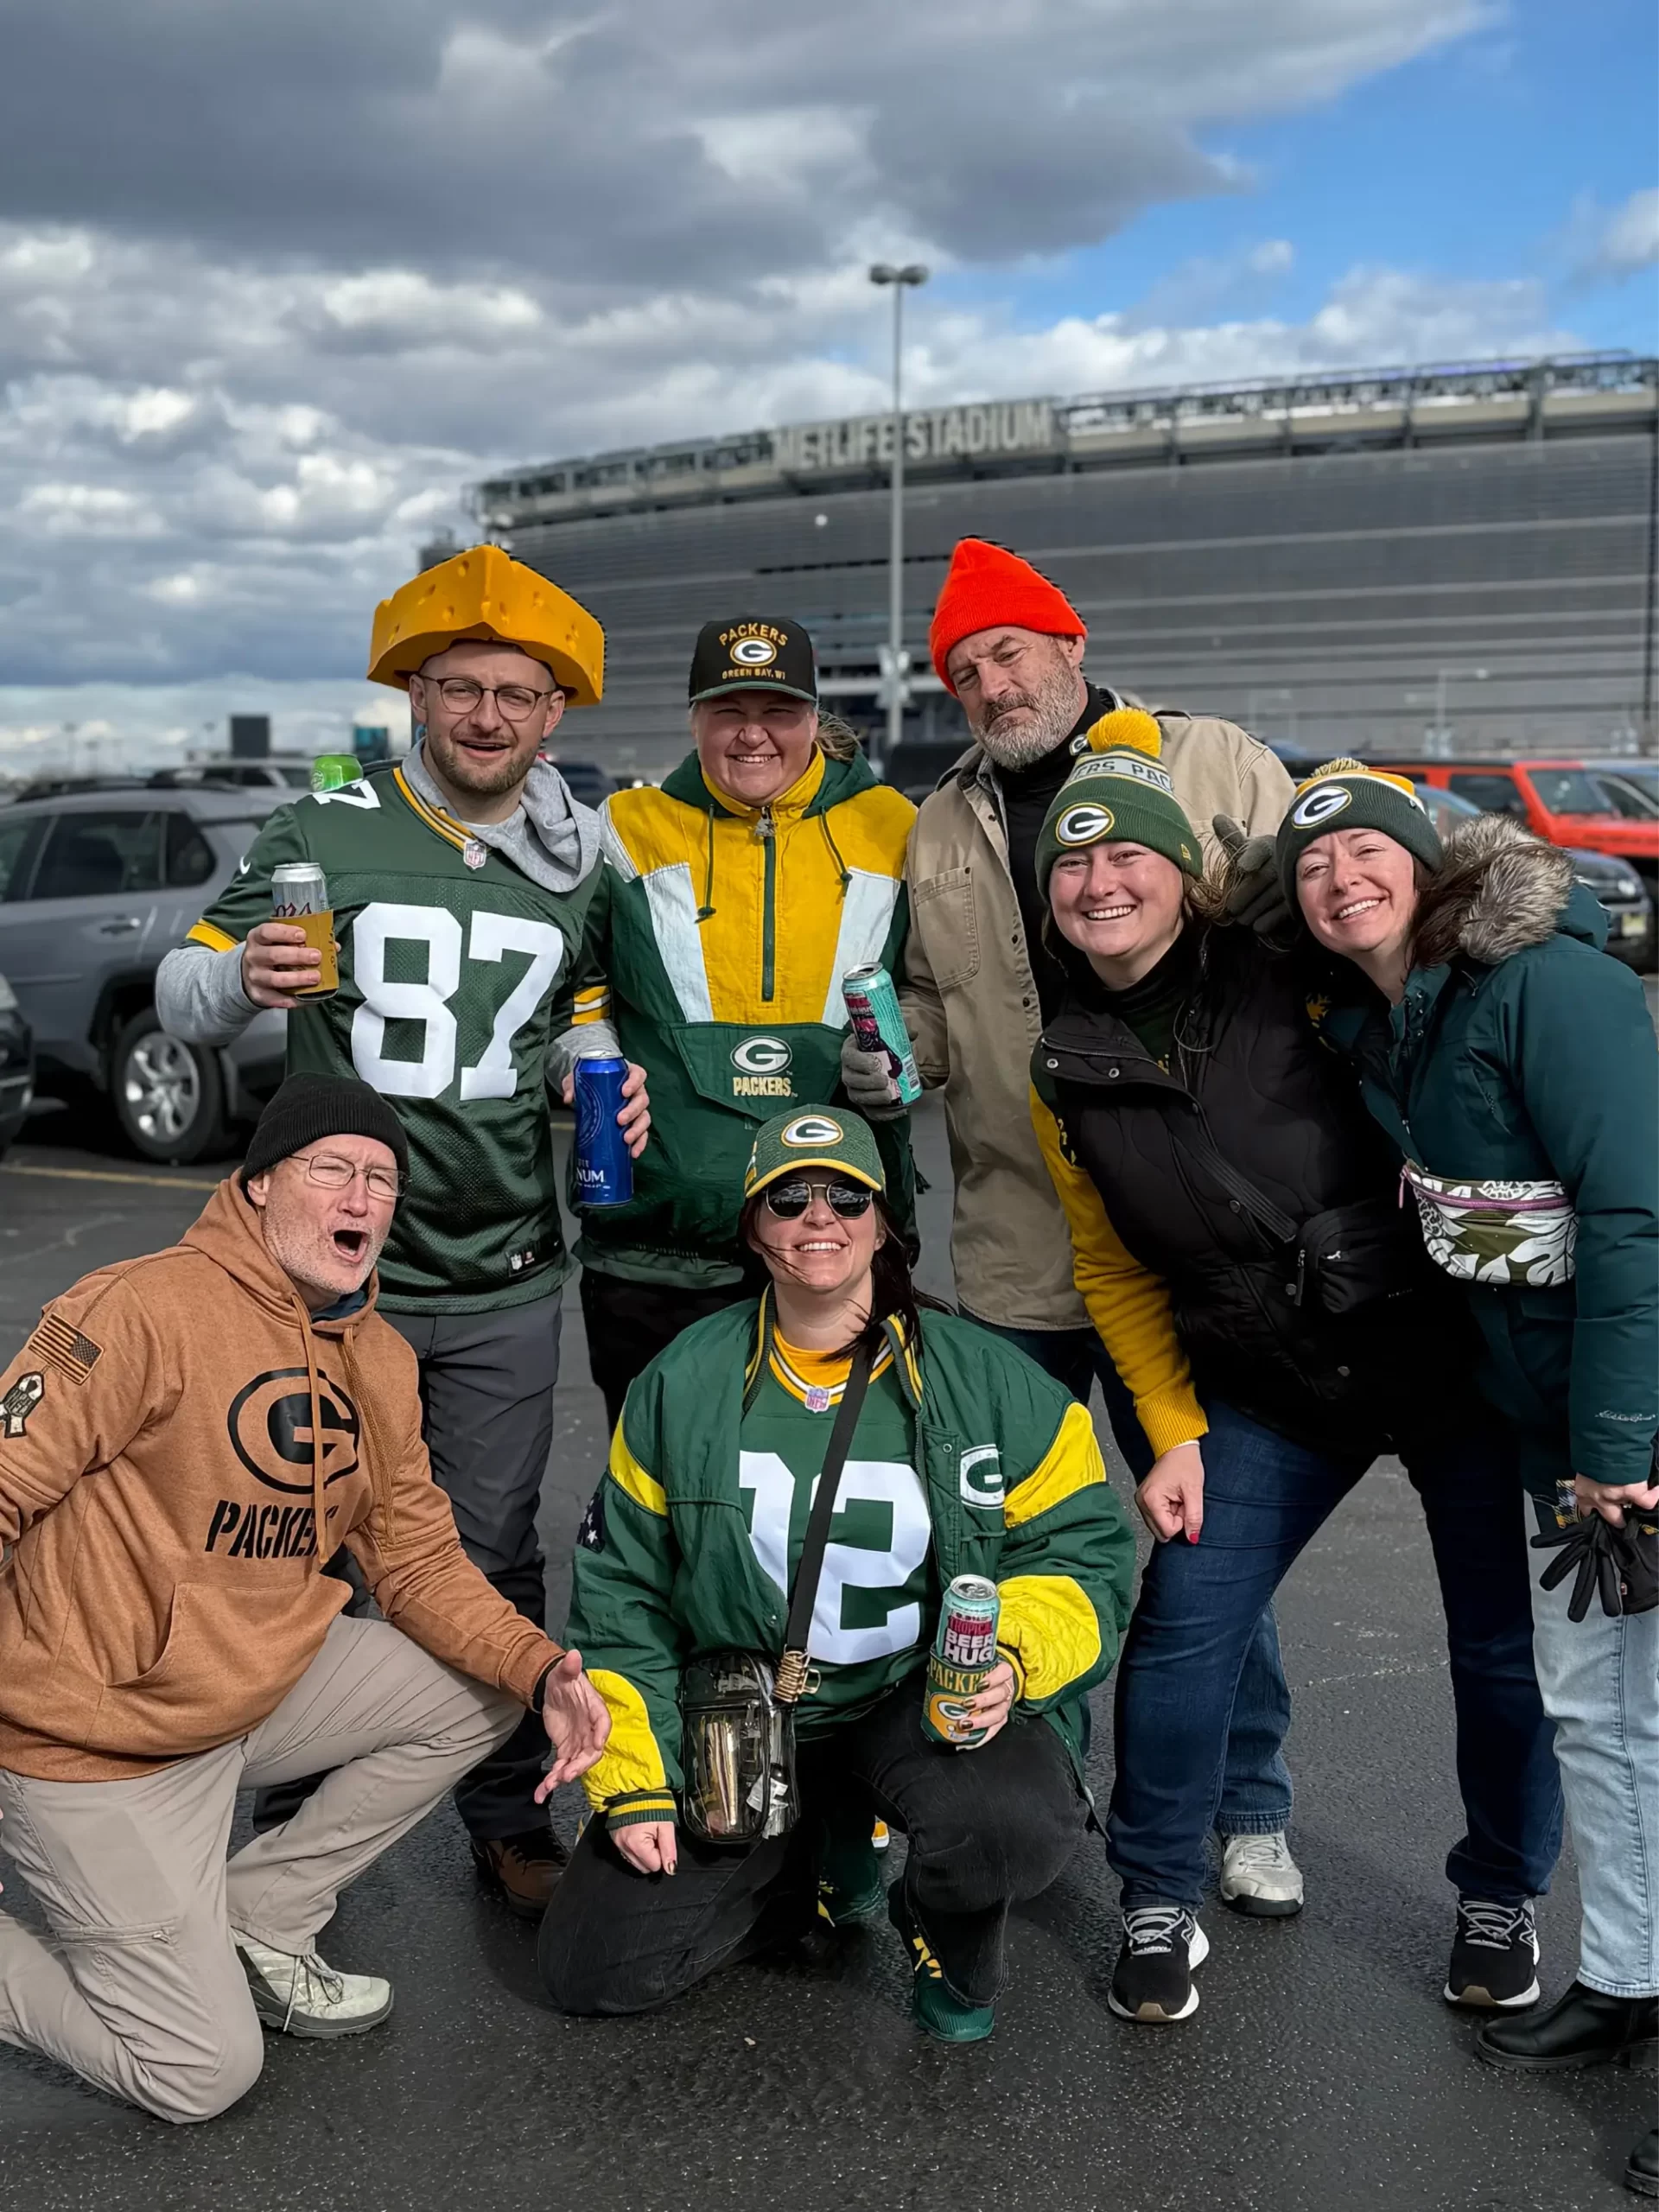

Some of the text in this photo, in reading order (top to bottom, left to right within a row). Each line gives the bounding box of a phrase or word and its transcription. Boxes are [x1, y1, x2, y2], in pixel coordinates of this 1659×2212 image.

[907, 403, 1052, 460] STADIUM
[719, 622, 789, 646] PACKERS
[733, 638, 775, 664] G
[721, 668, 753, 680] GREEN
[775, 670, 785, 680] WI
[1072, 761, 1173, 792] ERS PAC
[1058, 804, 1112, 844] G
[1294, 787, 1351, 827] G
[351, 902, 563, 1101] 87
[732, 1037, 791, 1075] G
[733, 1077, 792, 1096] PACKERS
[784, 1116, 842, 1145] G
[960, 1446, 1006, 1508] G
[205, 1500, 340, 1559] PACKE
[739, 1450, 931, 1664] 12
[944, 1641, 995, 1666] HUG
[946, 1627, 994, 1649] BEER
[931, 1656, 995, 1694] PACKE
